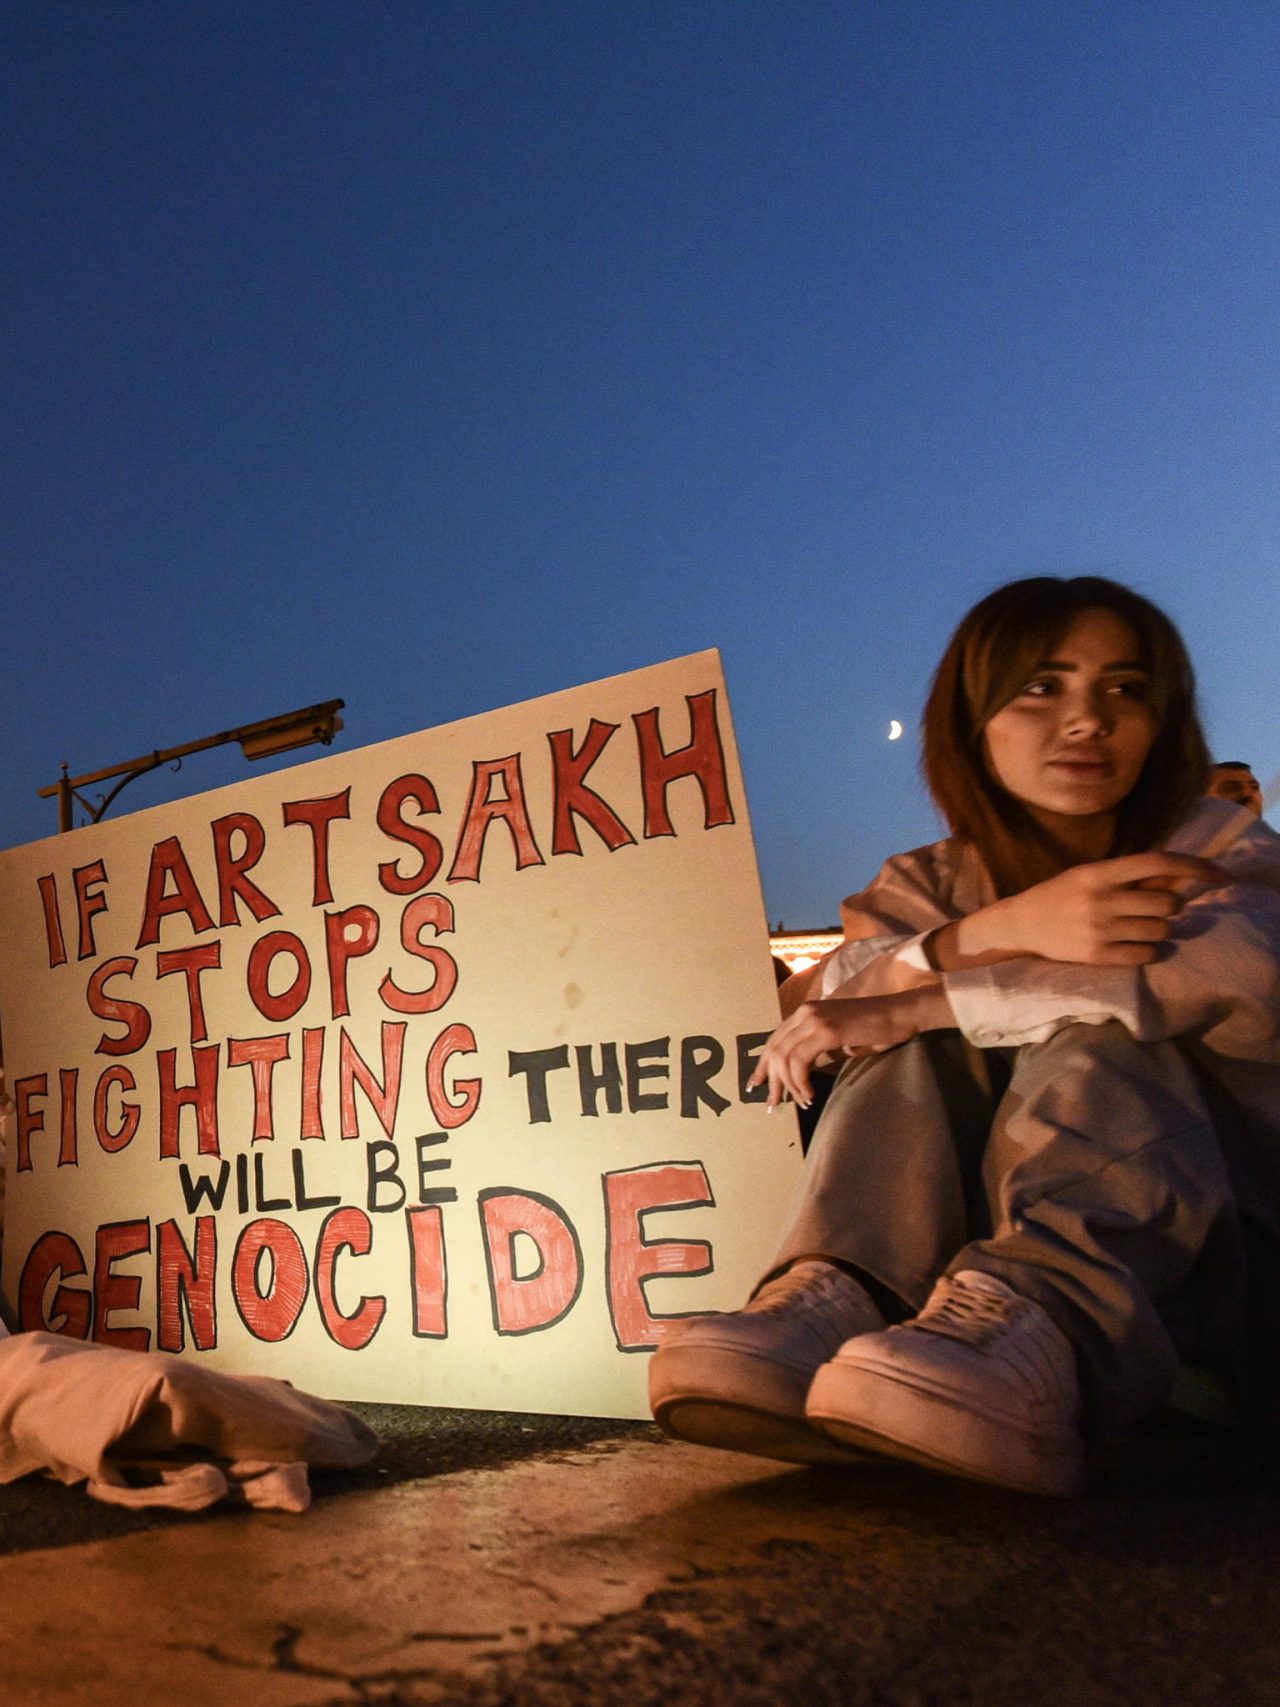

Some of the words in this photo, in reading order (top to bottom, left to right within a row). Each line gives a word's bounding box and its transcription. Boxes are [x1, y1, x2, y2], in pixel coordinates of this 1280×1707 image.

[37, 858, 111, 969] IF
[135, 688, 736, 950] ARTSAKH
[86, 893, 459, 1056] STOPS
[14, 1021, 483, 1173] FIGHTING
[508, 1030, 778, 1125] THERE
[179, 1149, 342, 1215] WILL
[366, 1131, 459, 1213] BE
[18, 1160, 740, 1354] GENOCIDE
